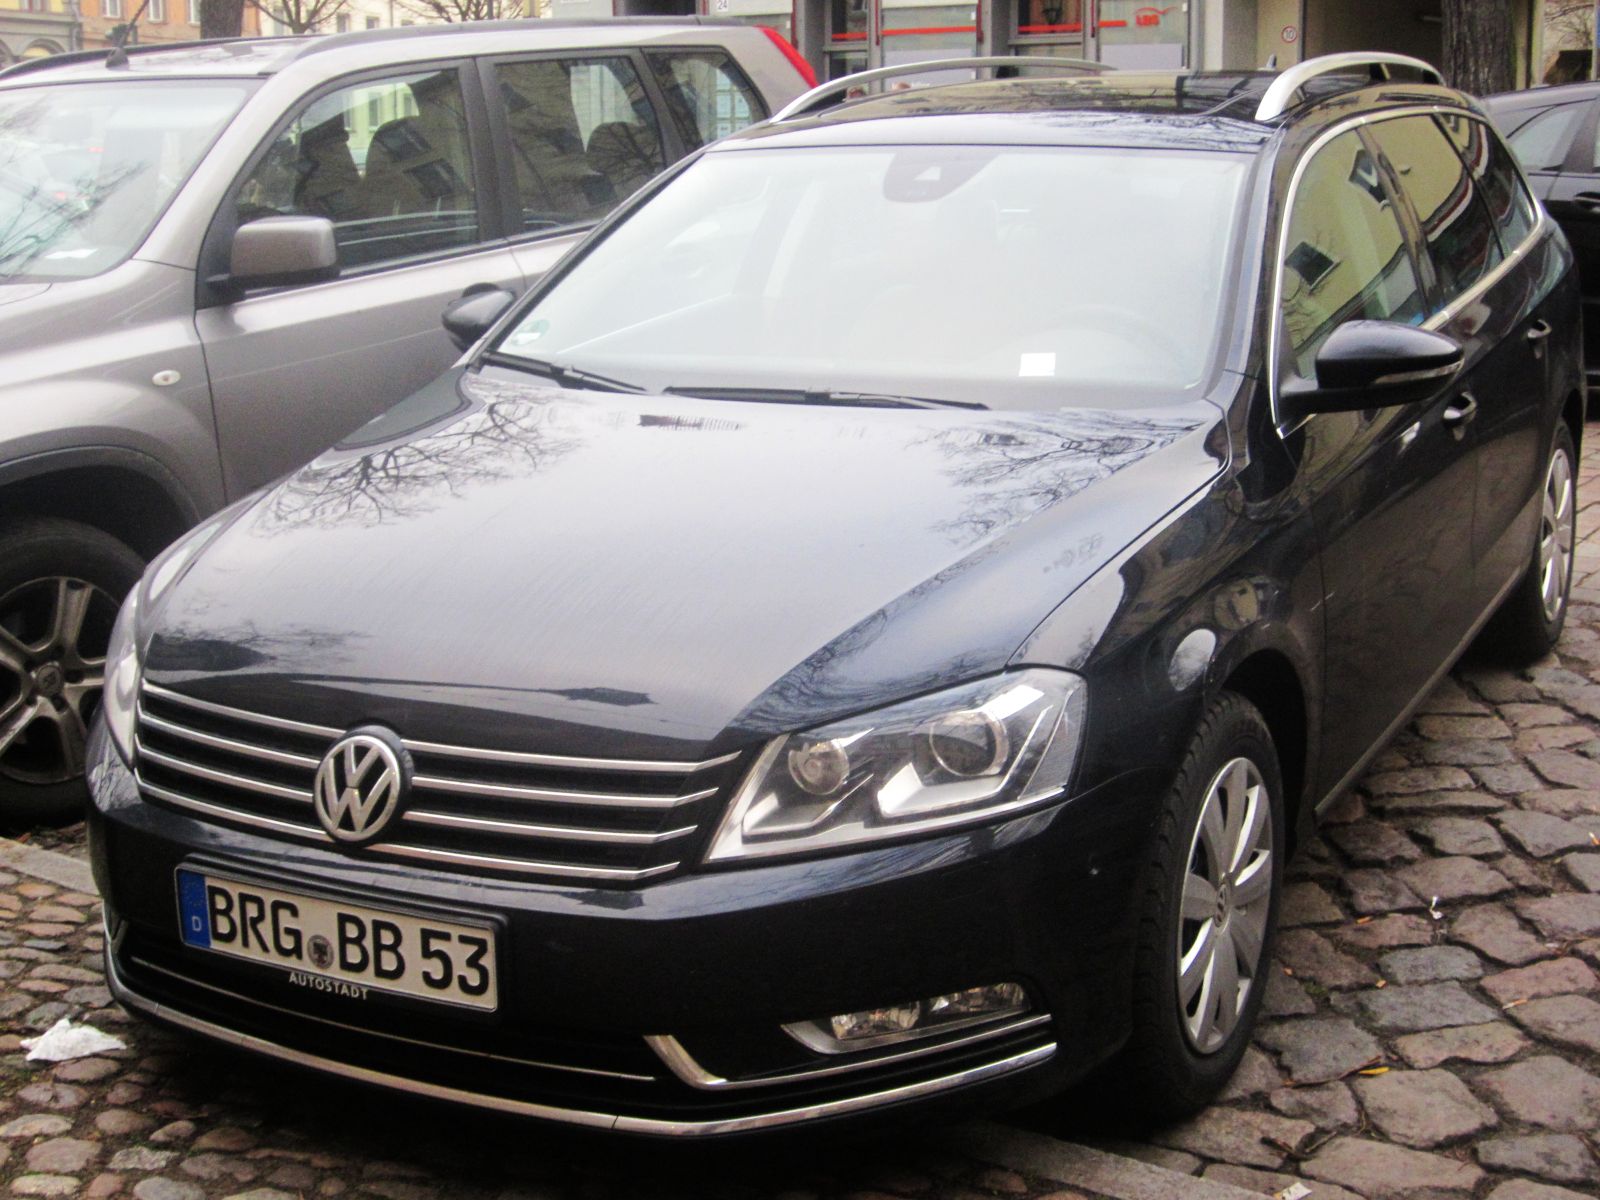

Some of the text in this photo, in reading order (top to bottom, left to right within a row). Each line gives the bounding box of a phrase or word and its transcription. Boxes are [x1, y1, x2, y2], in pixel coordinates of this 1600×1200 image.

[192, 915, 202, 932] D
[207, 885, 490, 996] BRG BB 53
[288, 971, 369, 1001] AUTOSTADT
